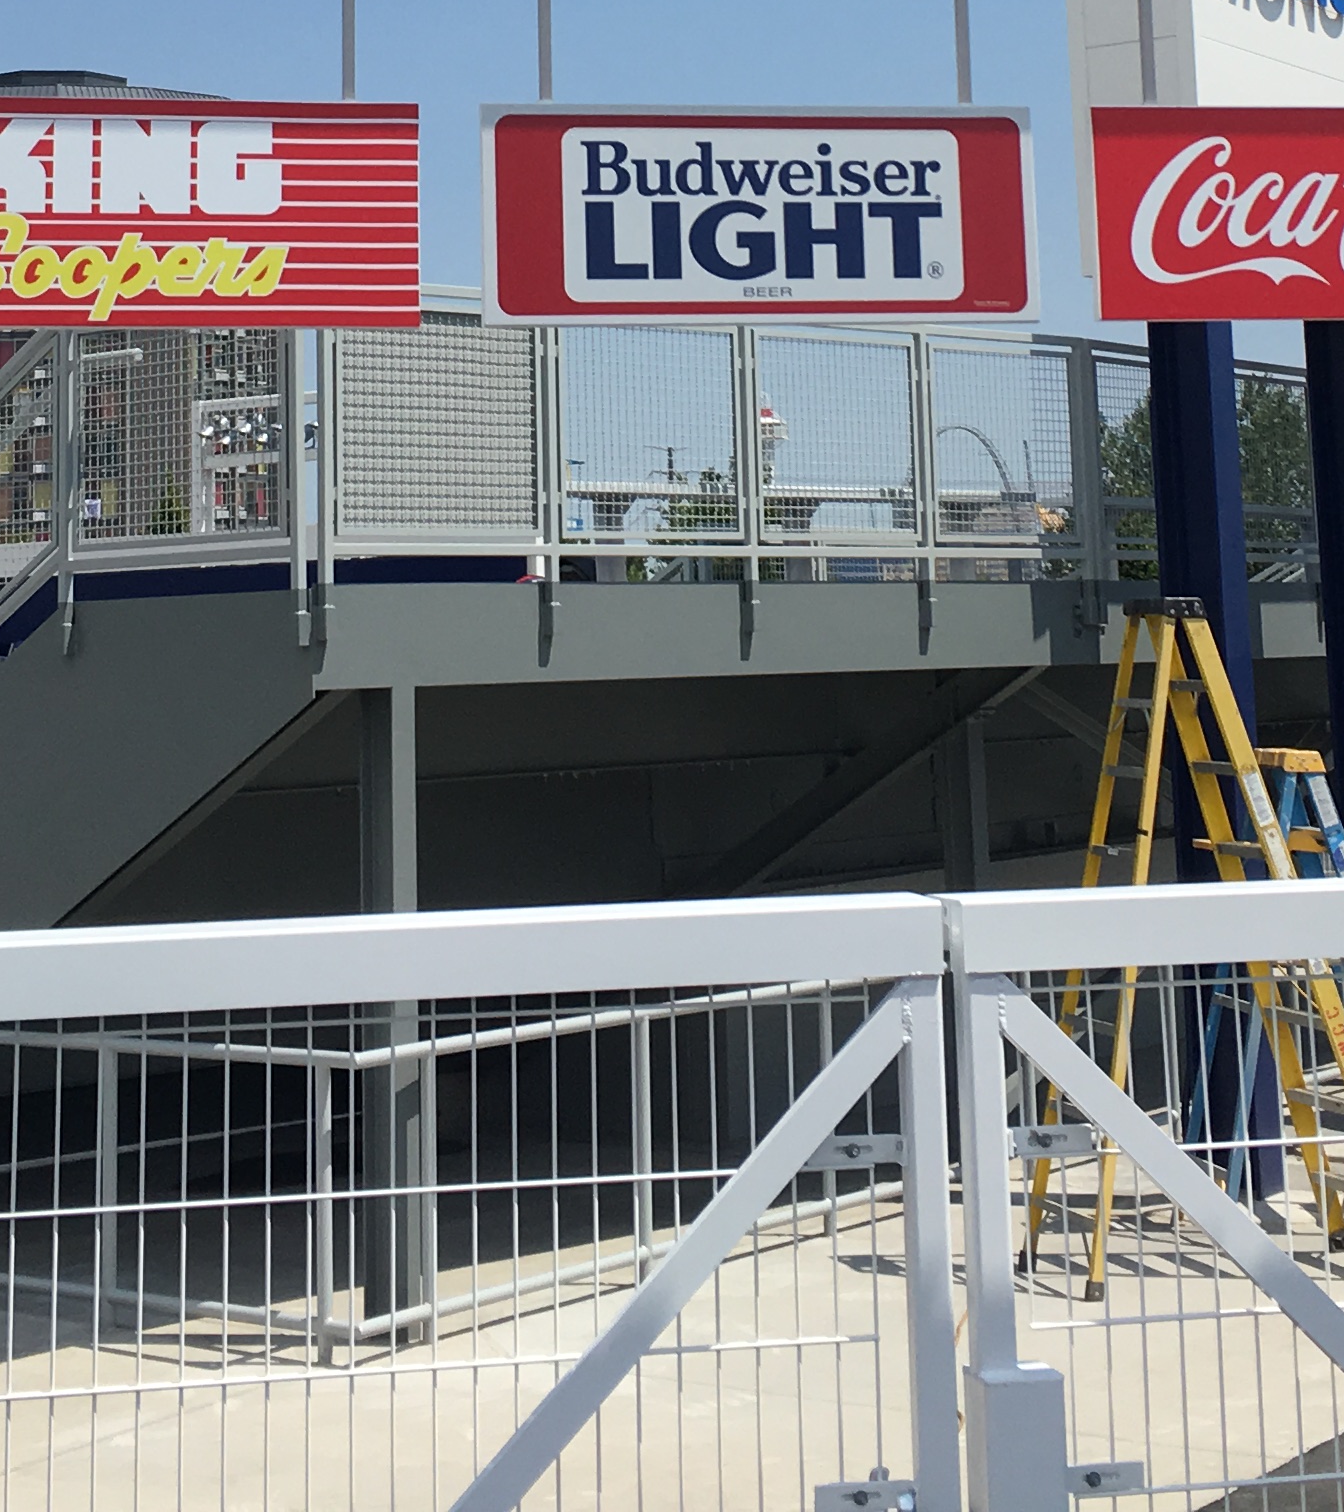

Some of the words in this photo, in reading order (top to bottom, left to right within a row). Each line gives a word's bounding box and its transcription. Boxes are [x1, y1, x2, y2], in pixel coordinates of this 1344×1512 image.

[579, 140, 942, 197] Budweiser
[585, 200, 943, 281] LIGHT
[742, 286, 793, 298] BEER
